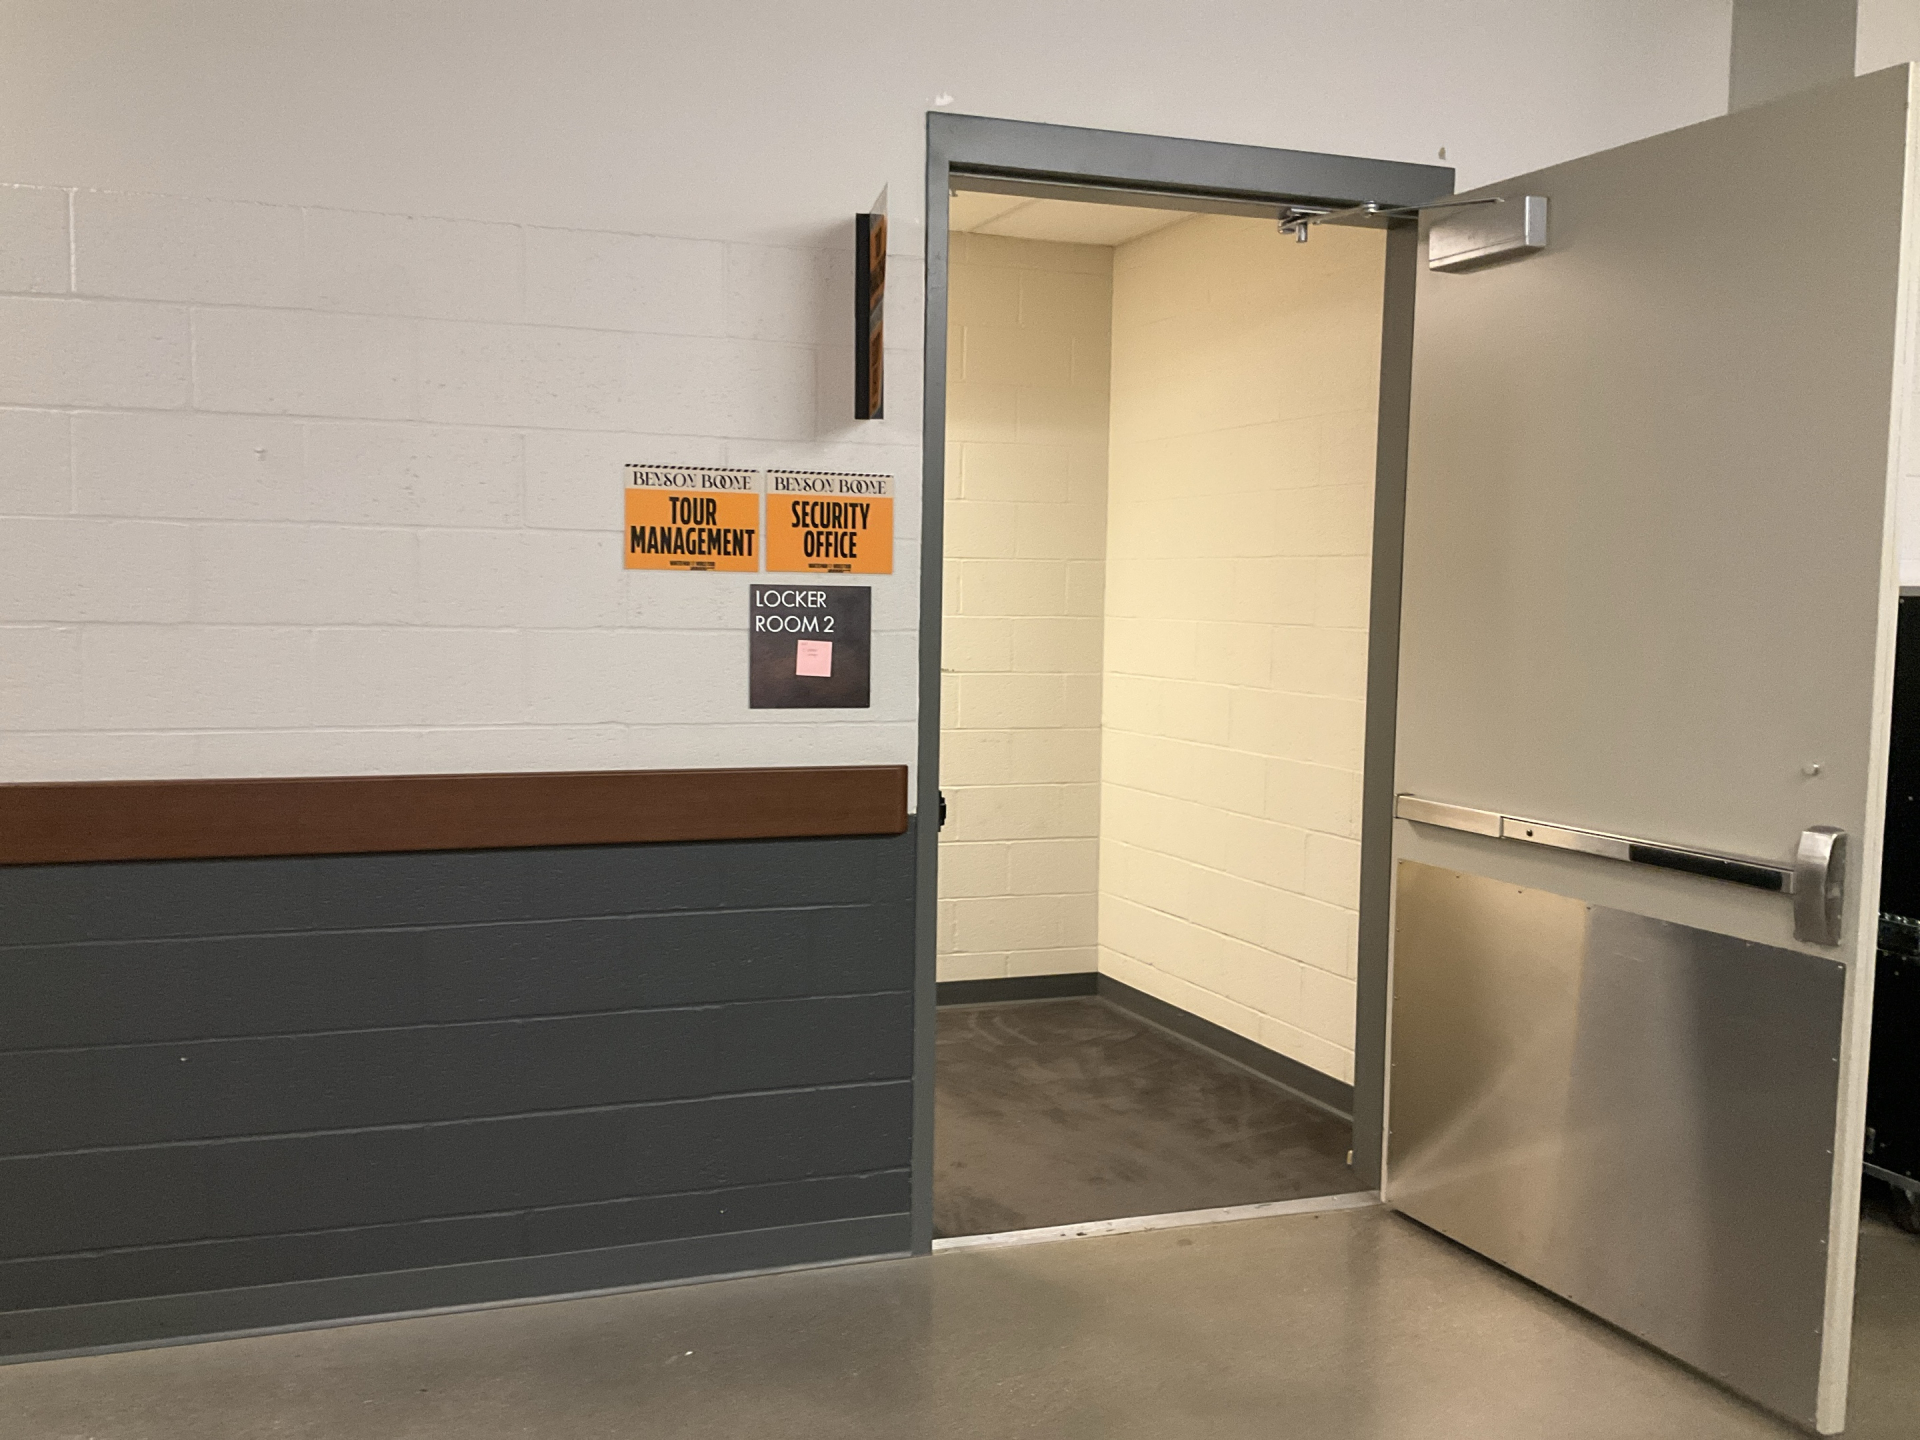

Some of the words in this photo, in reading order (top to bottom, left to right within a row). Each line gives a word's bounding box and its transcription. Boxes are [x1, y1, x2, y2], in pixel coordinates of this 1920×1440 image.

[633, 471, 696, 488] BENSON
[701, 473, 752, 490] BOONE
[774, 476, 834, 493] BENSON
[839, 479, 887, 495] BOONE
[668, 496, 717, 526] TOUR
[791, 500, 870, 530] SECURITY
[630, 525, 755, 556] MANAGEMENT
[803, 530, 857, 558] OFFICE
[756, 590, 827, 608] LOCKER
[755, 615, 820, 633] ROOM
[823, 615, 835, 633] 2
